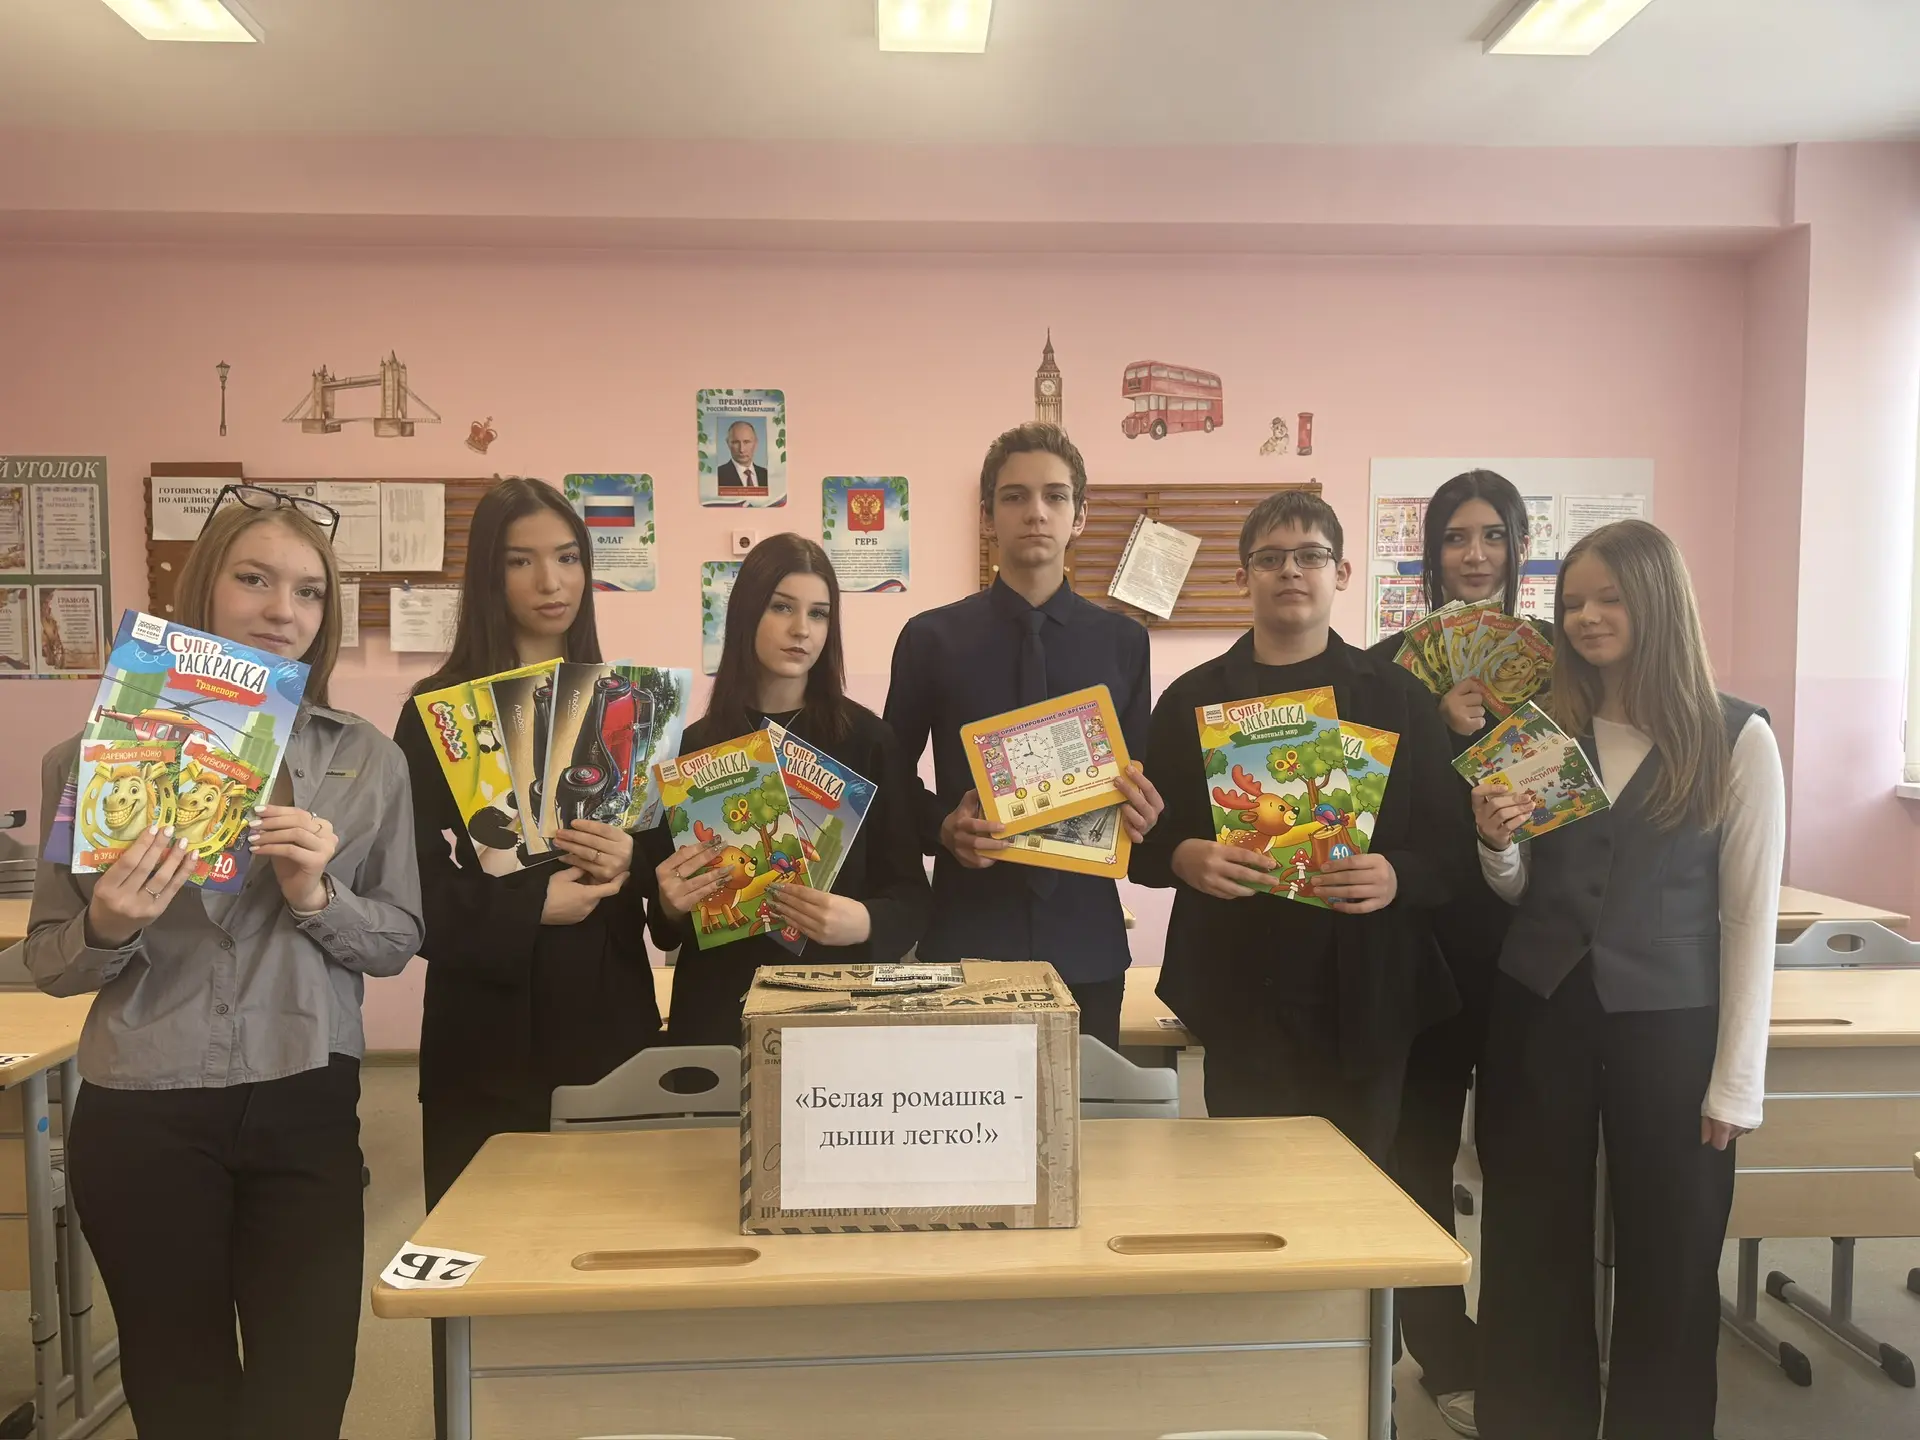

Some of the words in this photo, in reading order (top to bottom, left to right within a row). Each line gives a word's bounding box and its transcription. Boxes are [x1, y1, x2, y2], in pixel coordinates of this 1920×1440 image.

[14, 461, 99, 478] УГОЛОК
[159, 487, 211, 495] ГОТОВИМСЯ
[172, 496, 237, 504] АНГЛИЙСКМУ
[597, 536, 624, 544] ФЛАГ
[855, 538, 878, 546] ГЕРБ
[1521, 600, 1536, 609] 101
[179, 654, 267, 693] РАСКРАСКА
[196, 679, 240, 699] Транспорт
[1000, 714, 1057, 735] ОРИЕНТИРОВАНИЕ
[1067, 703, 1097, 714] ВРЕМЕНИ
[1240, 705, 1305, 734] РАСКРАСКА
[1250, 730, 1284, 740] Животный
[1285, 728, 1299, 737] мир
[100, 752, 137, 760] ДАРЕНОМУ
[140, 750, 162, 758] КОНЮ
[198, 753, 230, 771] ДАРЕНОМУ
[231, 767, 250, 781] КОНЮ
[693, 751, 748, 787] РАСКРАСКА
[1519, 764, 1563, 787] ПЛАСТИЛИН
[704, 780, 733, 793] Животный
[787, 758, 844, 799] РАСКРАСКА
[796, 780, 823, 800] Транспорт
[94, 853, 99, 861] В
[1332, 845, 1349, 858] 40
[214, 855, 233, 874] 40
[795, 1086, 884, 1109] «Белая
[892, 1089, 1006, 1113] ромашка
[819, 1129, 895, 1149] дыши
[902, 1122, 998, 1145] легко!»
[393, 1253, 477, 1281] 2Б
